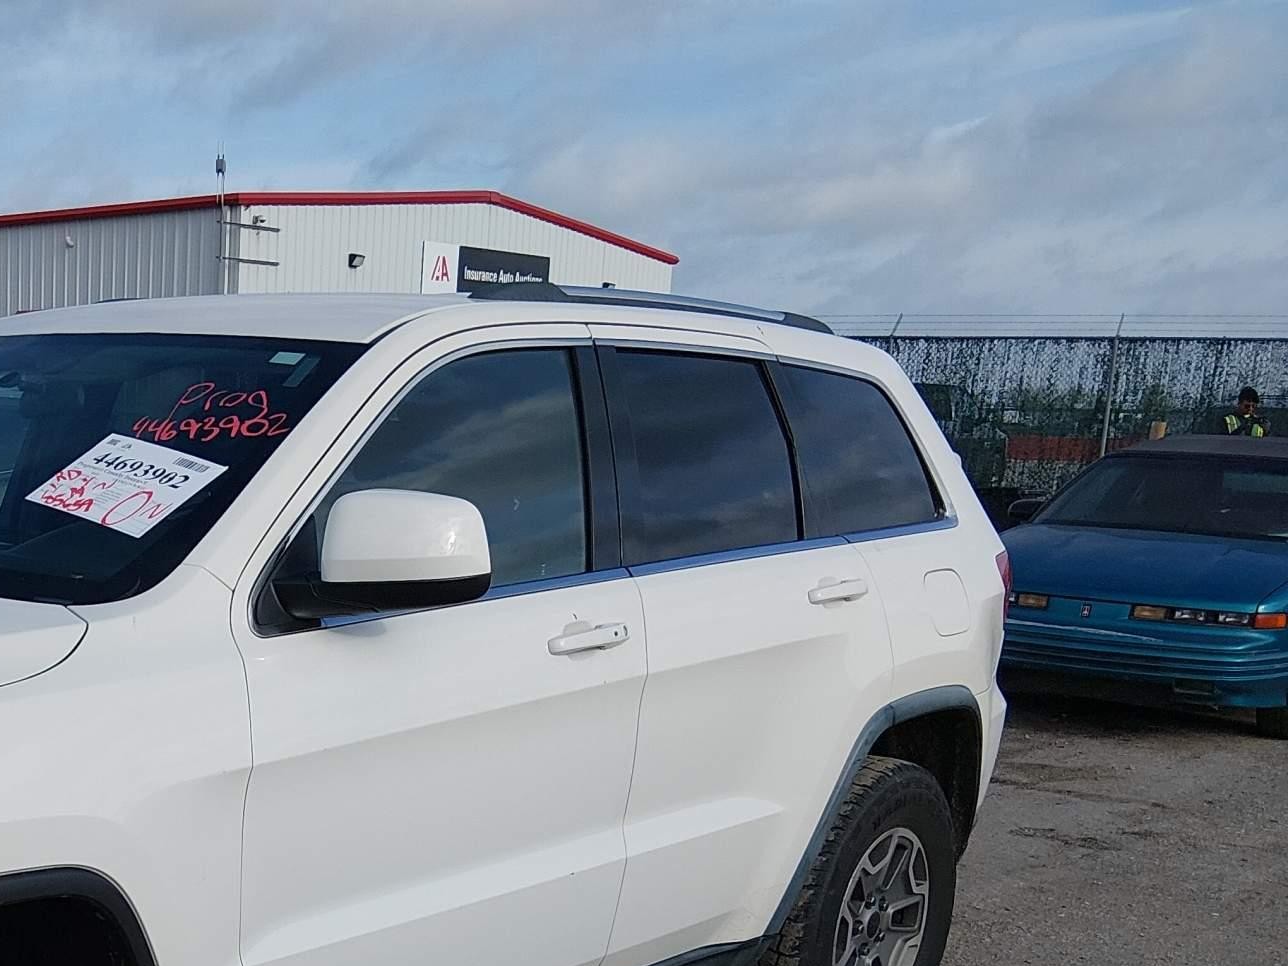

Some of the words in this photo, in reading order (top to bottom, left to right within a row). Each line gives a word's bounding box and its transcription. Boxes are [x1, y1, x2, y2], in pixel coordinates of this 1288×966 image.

[464, 266, 498, 282] Insurance
[498, 269, 514, 284] Auto
[133, 413, 291, 441] 44693902
[93, 452, 190, 488] 44693902
